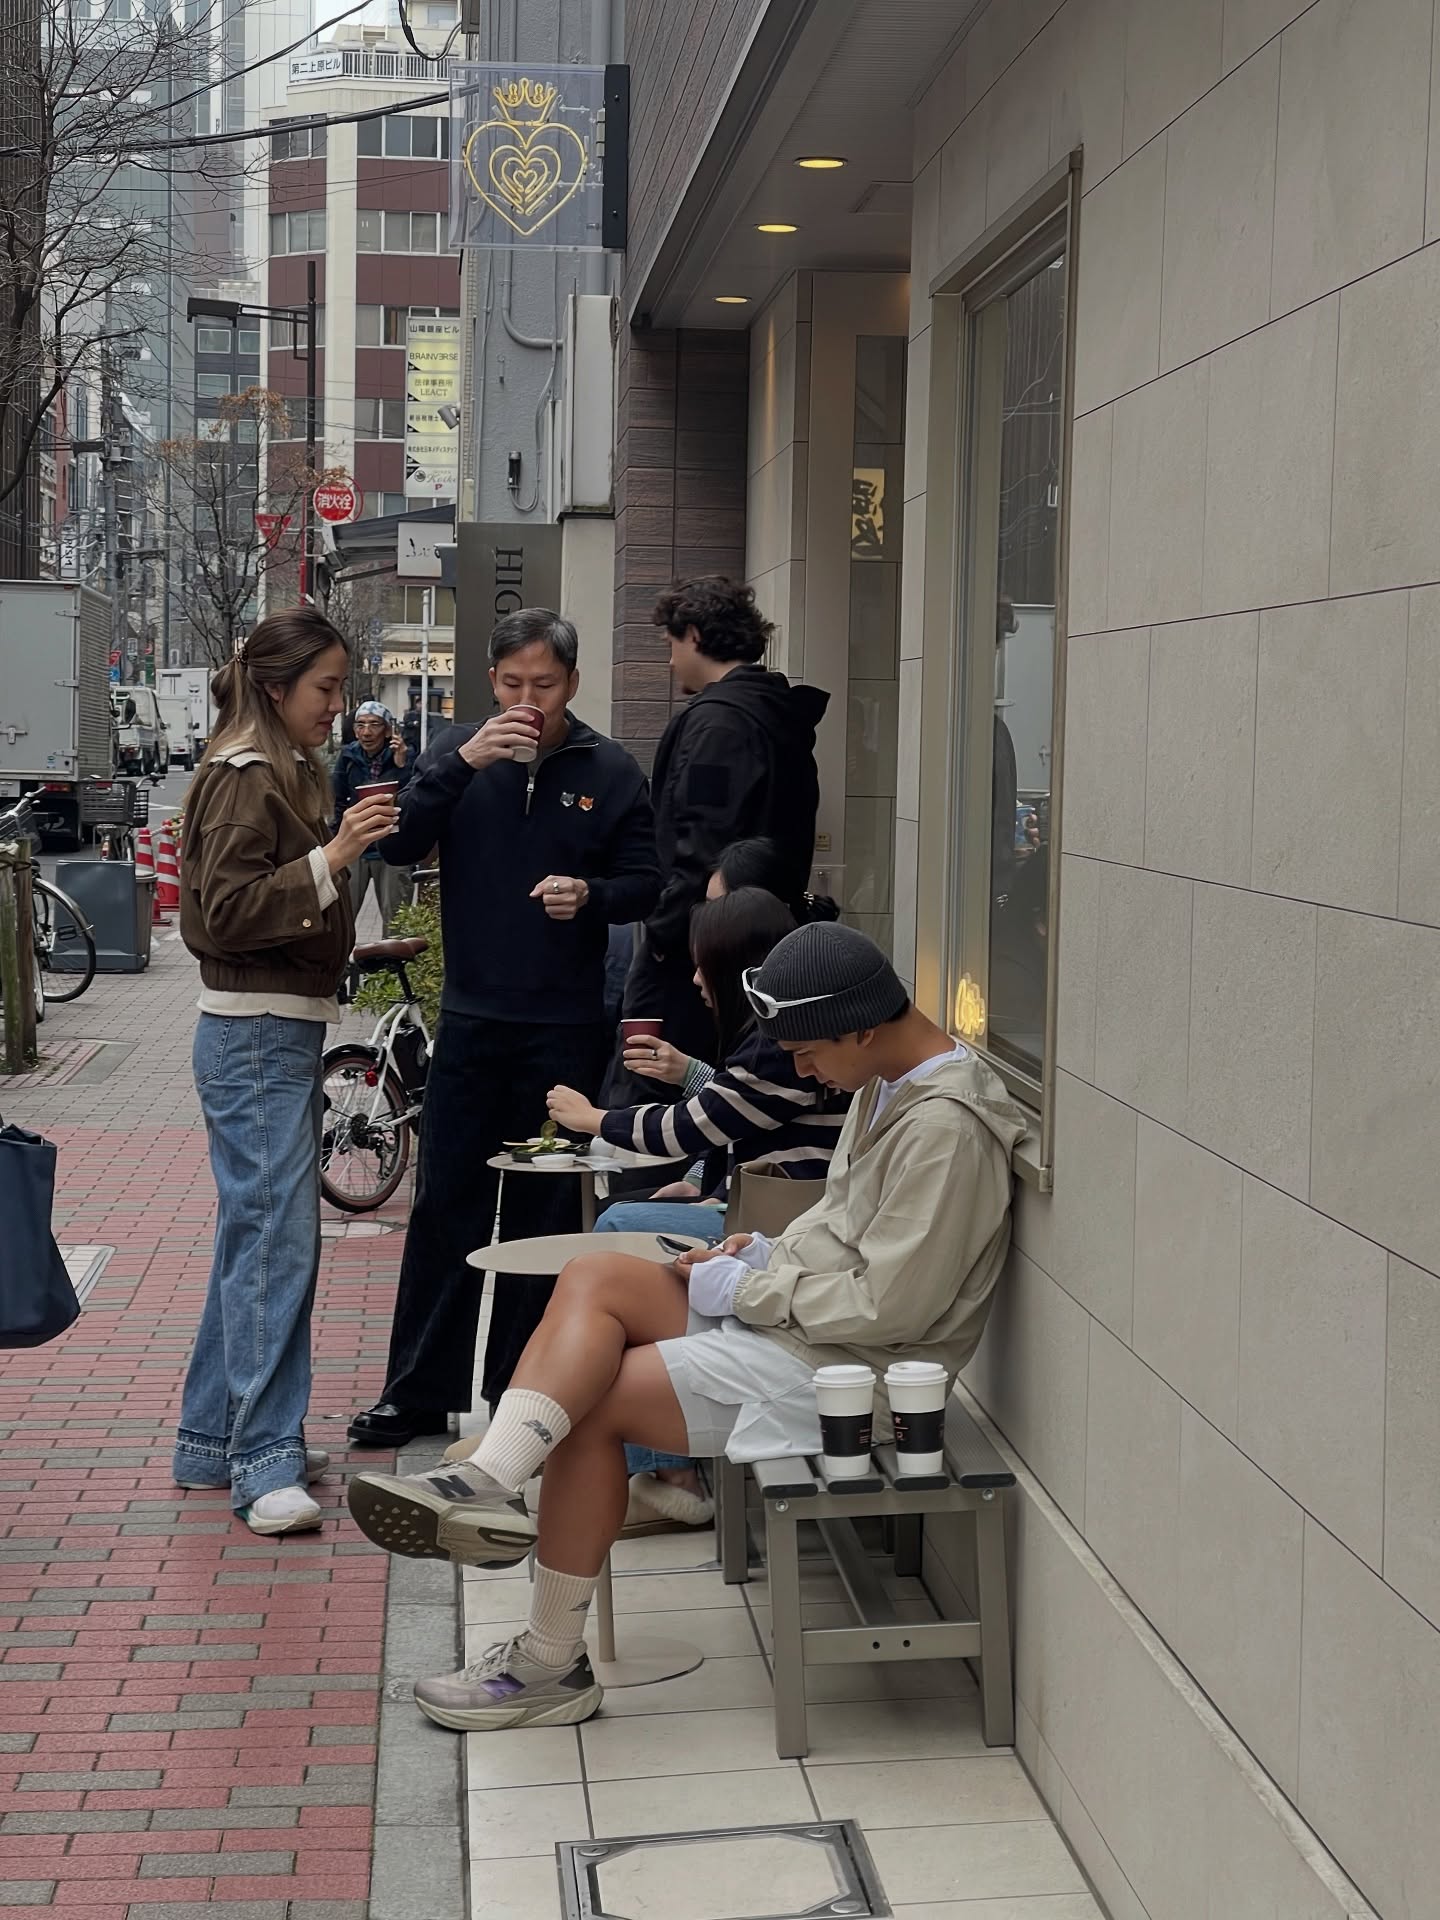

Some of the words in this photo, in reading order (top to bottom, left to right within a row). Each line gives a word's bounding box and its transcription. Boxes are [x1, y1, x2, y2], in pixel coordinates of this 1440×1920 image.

[291, 58, 341, 75] 第二上原ビル
[420, 388, 448, 397] LEACT
[318, 493, 352, 510] 消火栓
[495, 546, 524, 624] HIG
